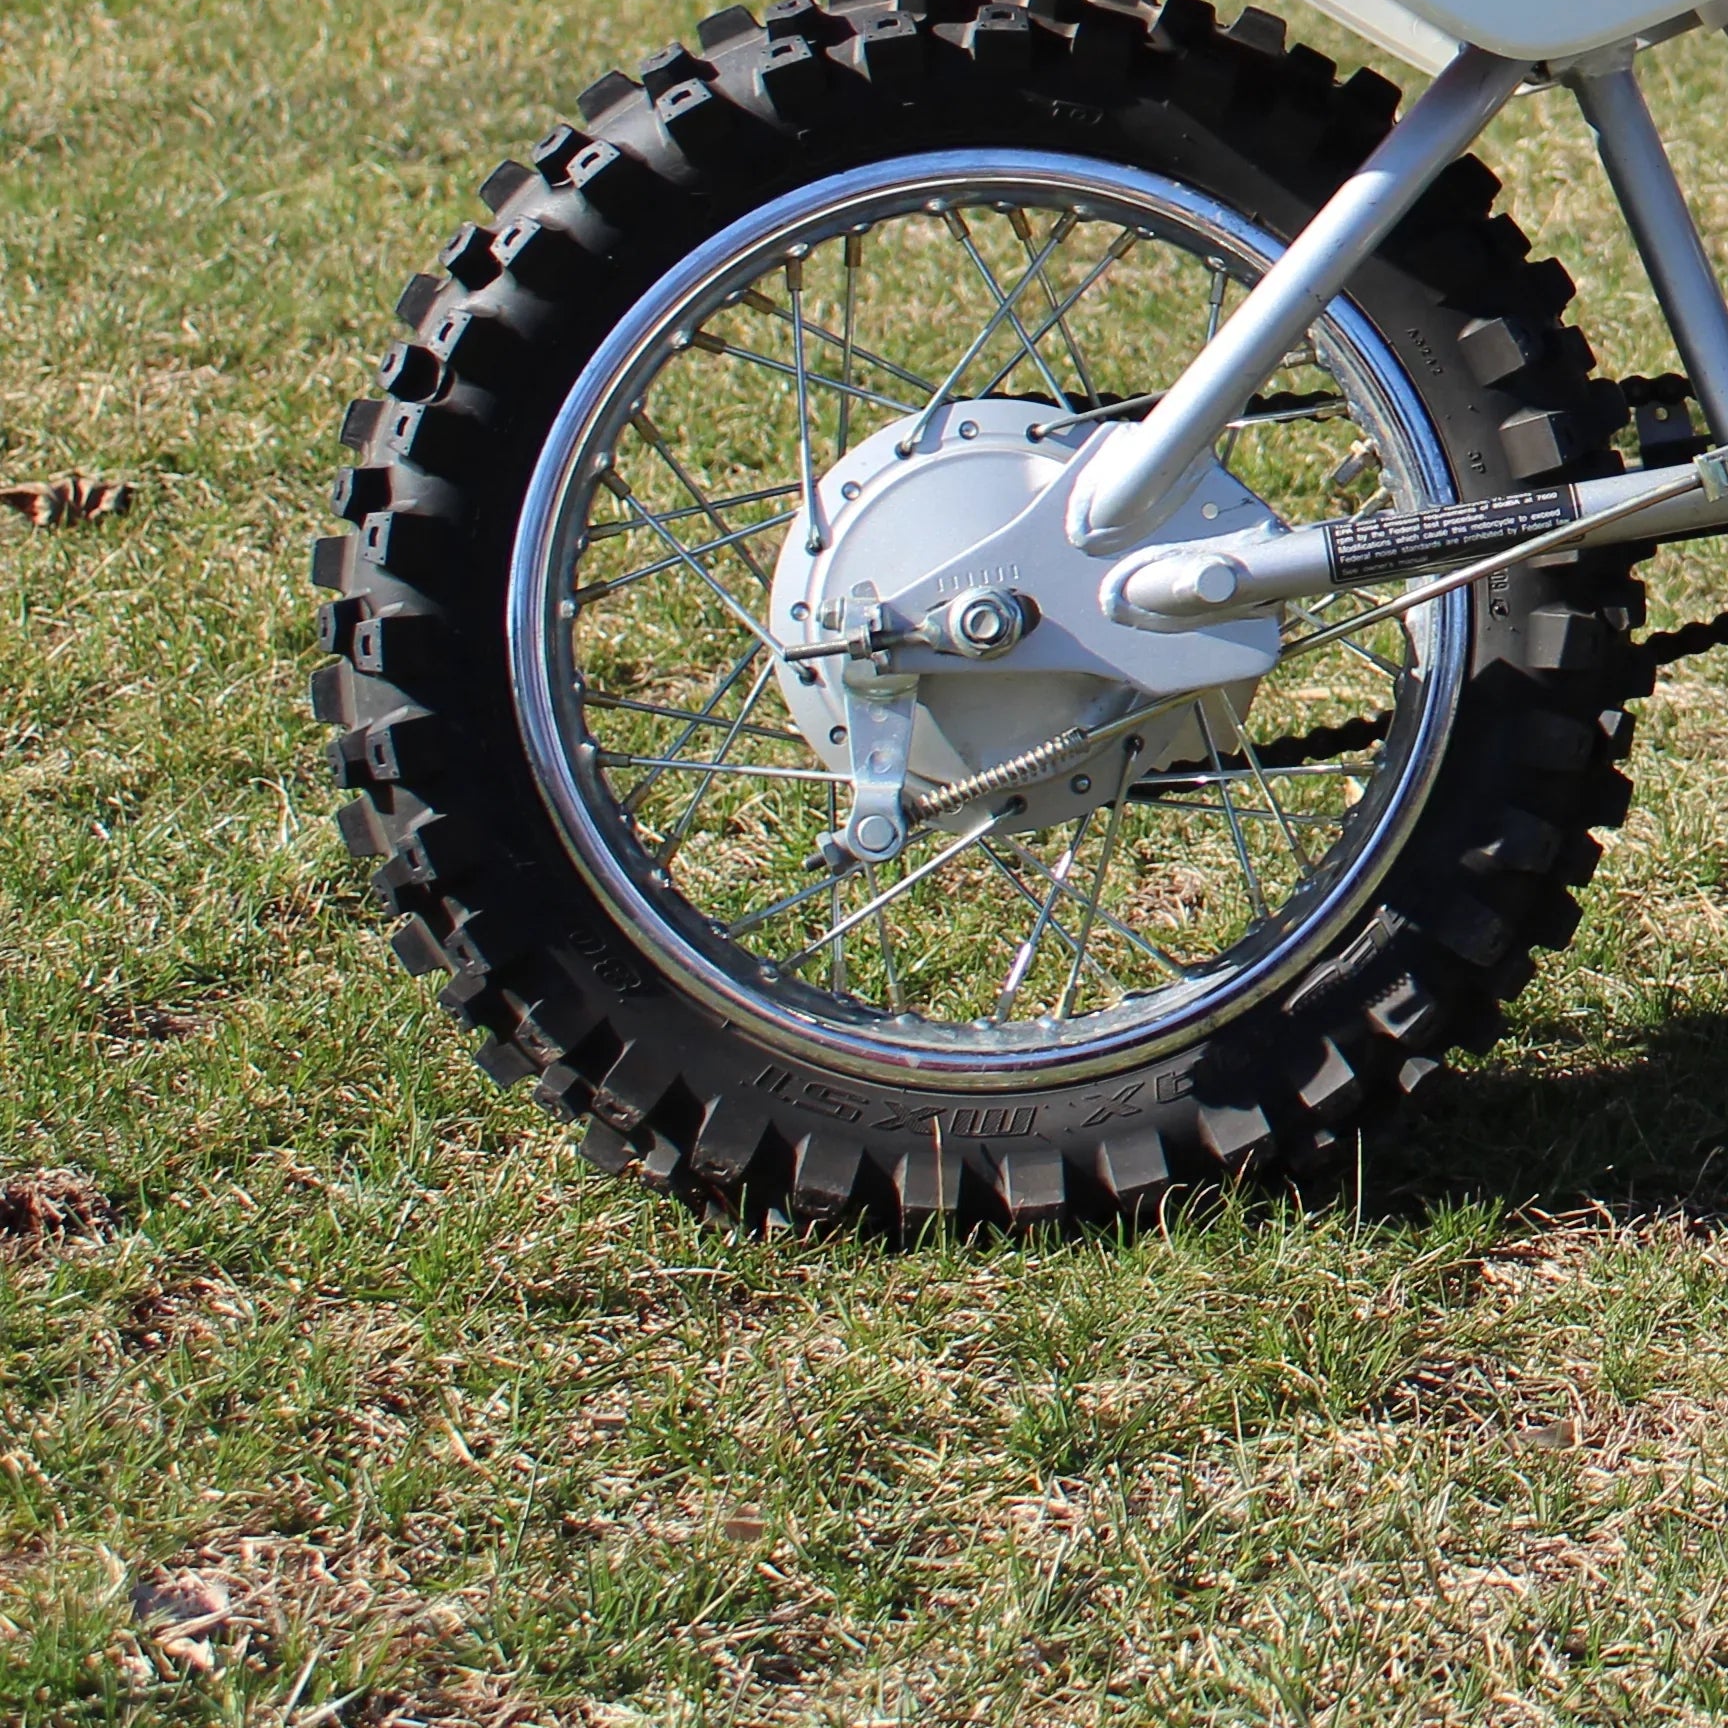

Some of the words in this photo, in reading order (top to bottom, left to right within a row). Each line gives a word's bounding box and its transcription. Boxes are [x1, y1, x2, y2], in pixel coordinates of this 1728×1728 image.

[1337, 539, 1393, 554] Modifications
[1395, 534, 1420, 544] which
[1422, 529, 1449, 540] cause
[1451, 525, 1468, 535] this
[1470, 517, 1515, 531] motorcycle
[1518, 515, 1528, 523] to
[1530, 507, 1561, 521] exceed
[1340, 552, 1371, 564] Federal
[1374, 549, 1398, 558] noise
[1401, 540, 1442, 553] standards
[1445, 537, 1460, 546] are
[1463, 529, 1504, 544] prohibited
[1506, 527, 1518, 536] by
[1521, 519, 1553, 532] Federal
[1356, 534, 1368, 542] by
[1371, 531, 1386, 539] the
[1388, 524, 1420, 535] Federal
[1423, 520, 1440, 529] test
